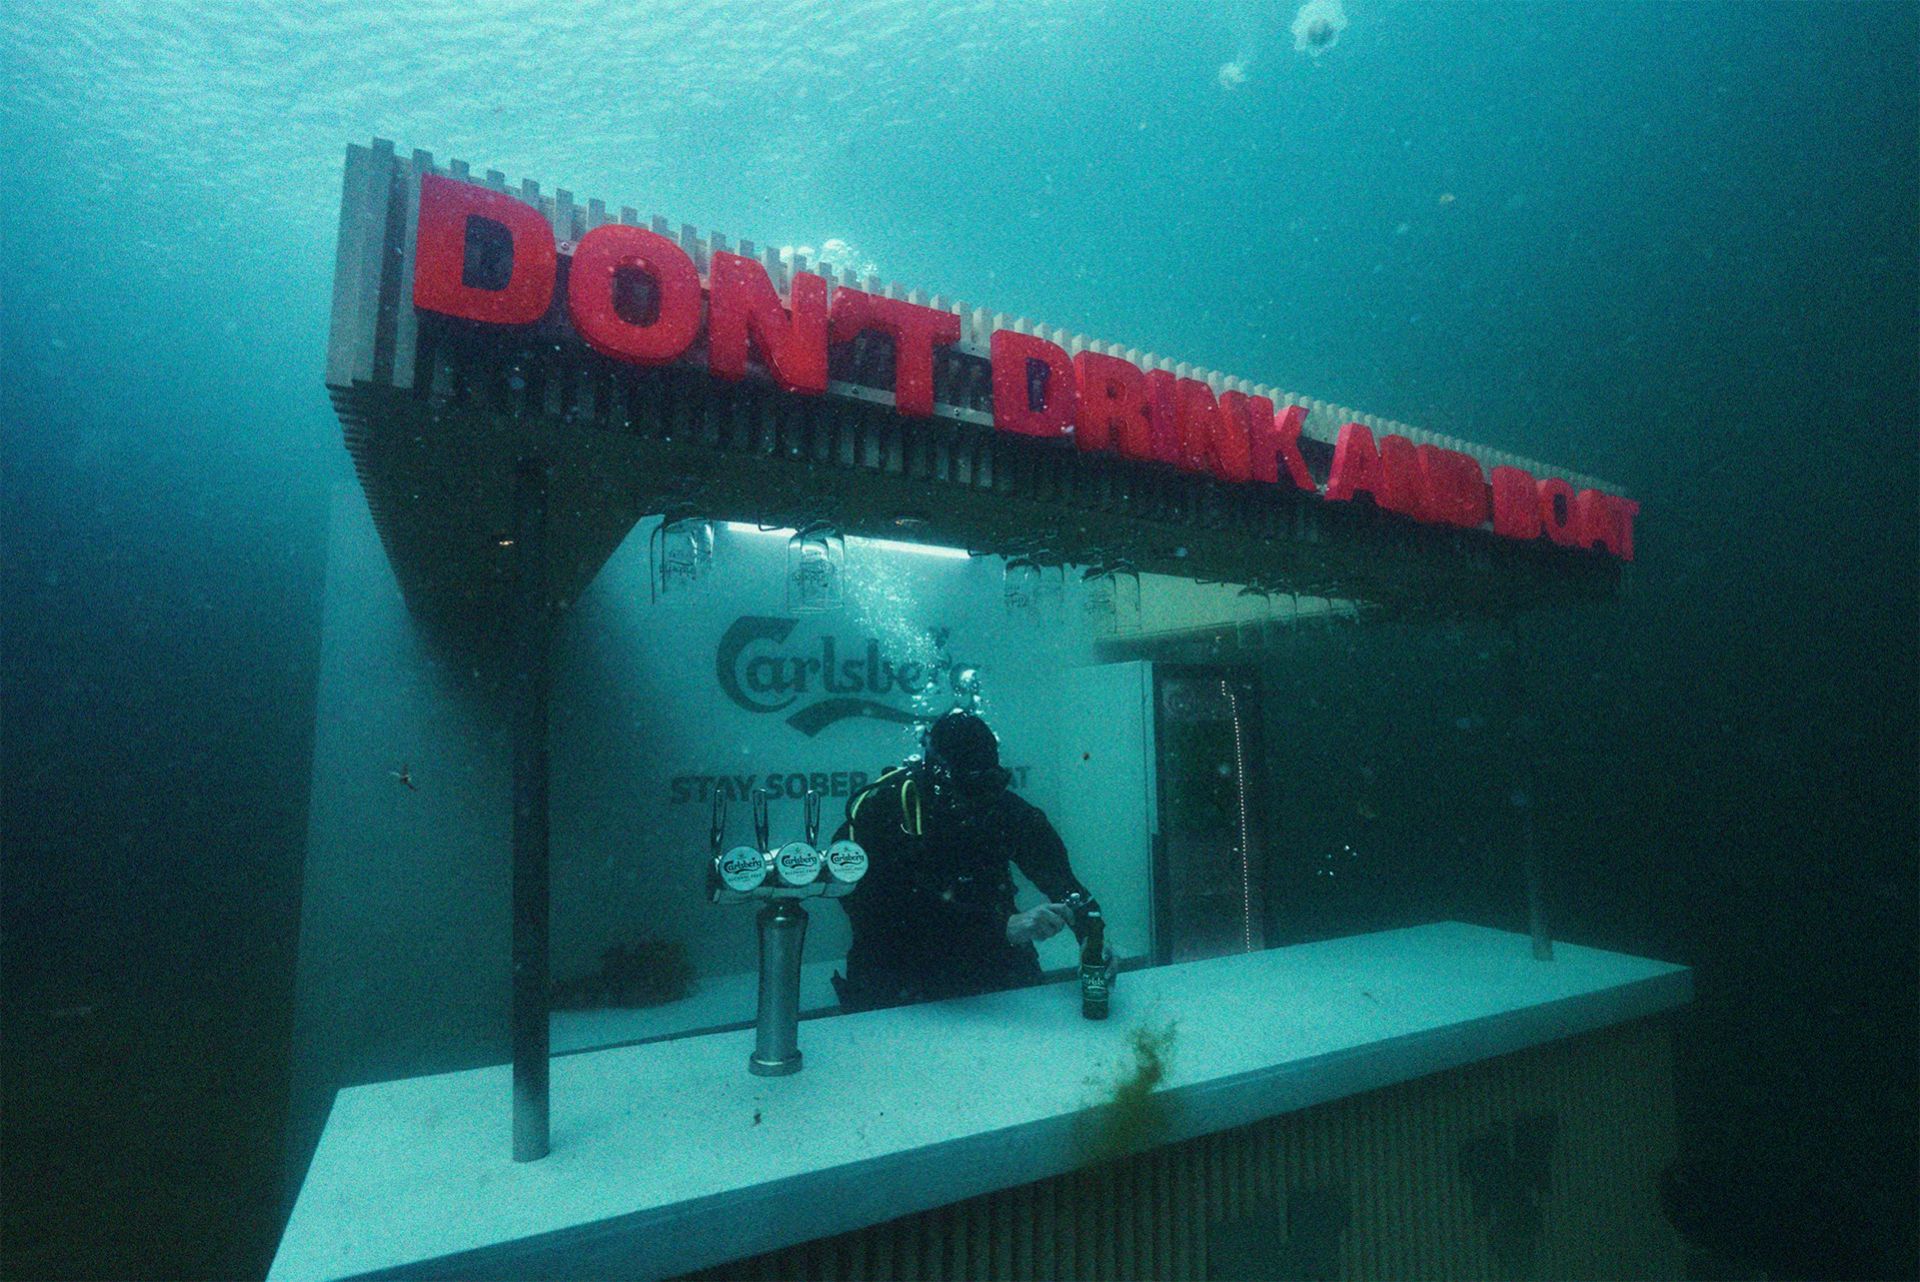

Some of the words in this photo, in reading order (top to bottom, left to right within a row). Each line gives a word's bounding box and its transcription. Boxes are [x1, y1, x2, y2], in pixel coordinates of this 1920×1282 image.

[991, 328, 1319, 491] DRINK
[1324, 422, 1488, 528] AND
[1490, 465, 1641, 561] BOAT
[670, 773, 757, 804] STAY
[765, 770, 868, 801] SOBER
[723, 857, 763, 874] Carlsberg
[780, 853, 818, 869] Carlsberg
[830, 850, 865, 867] Carlsberg
